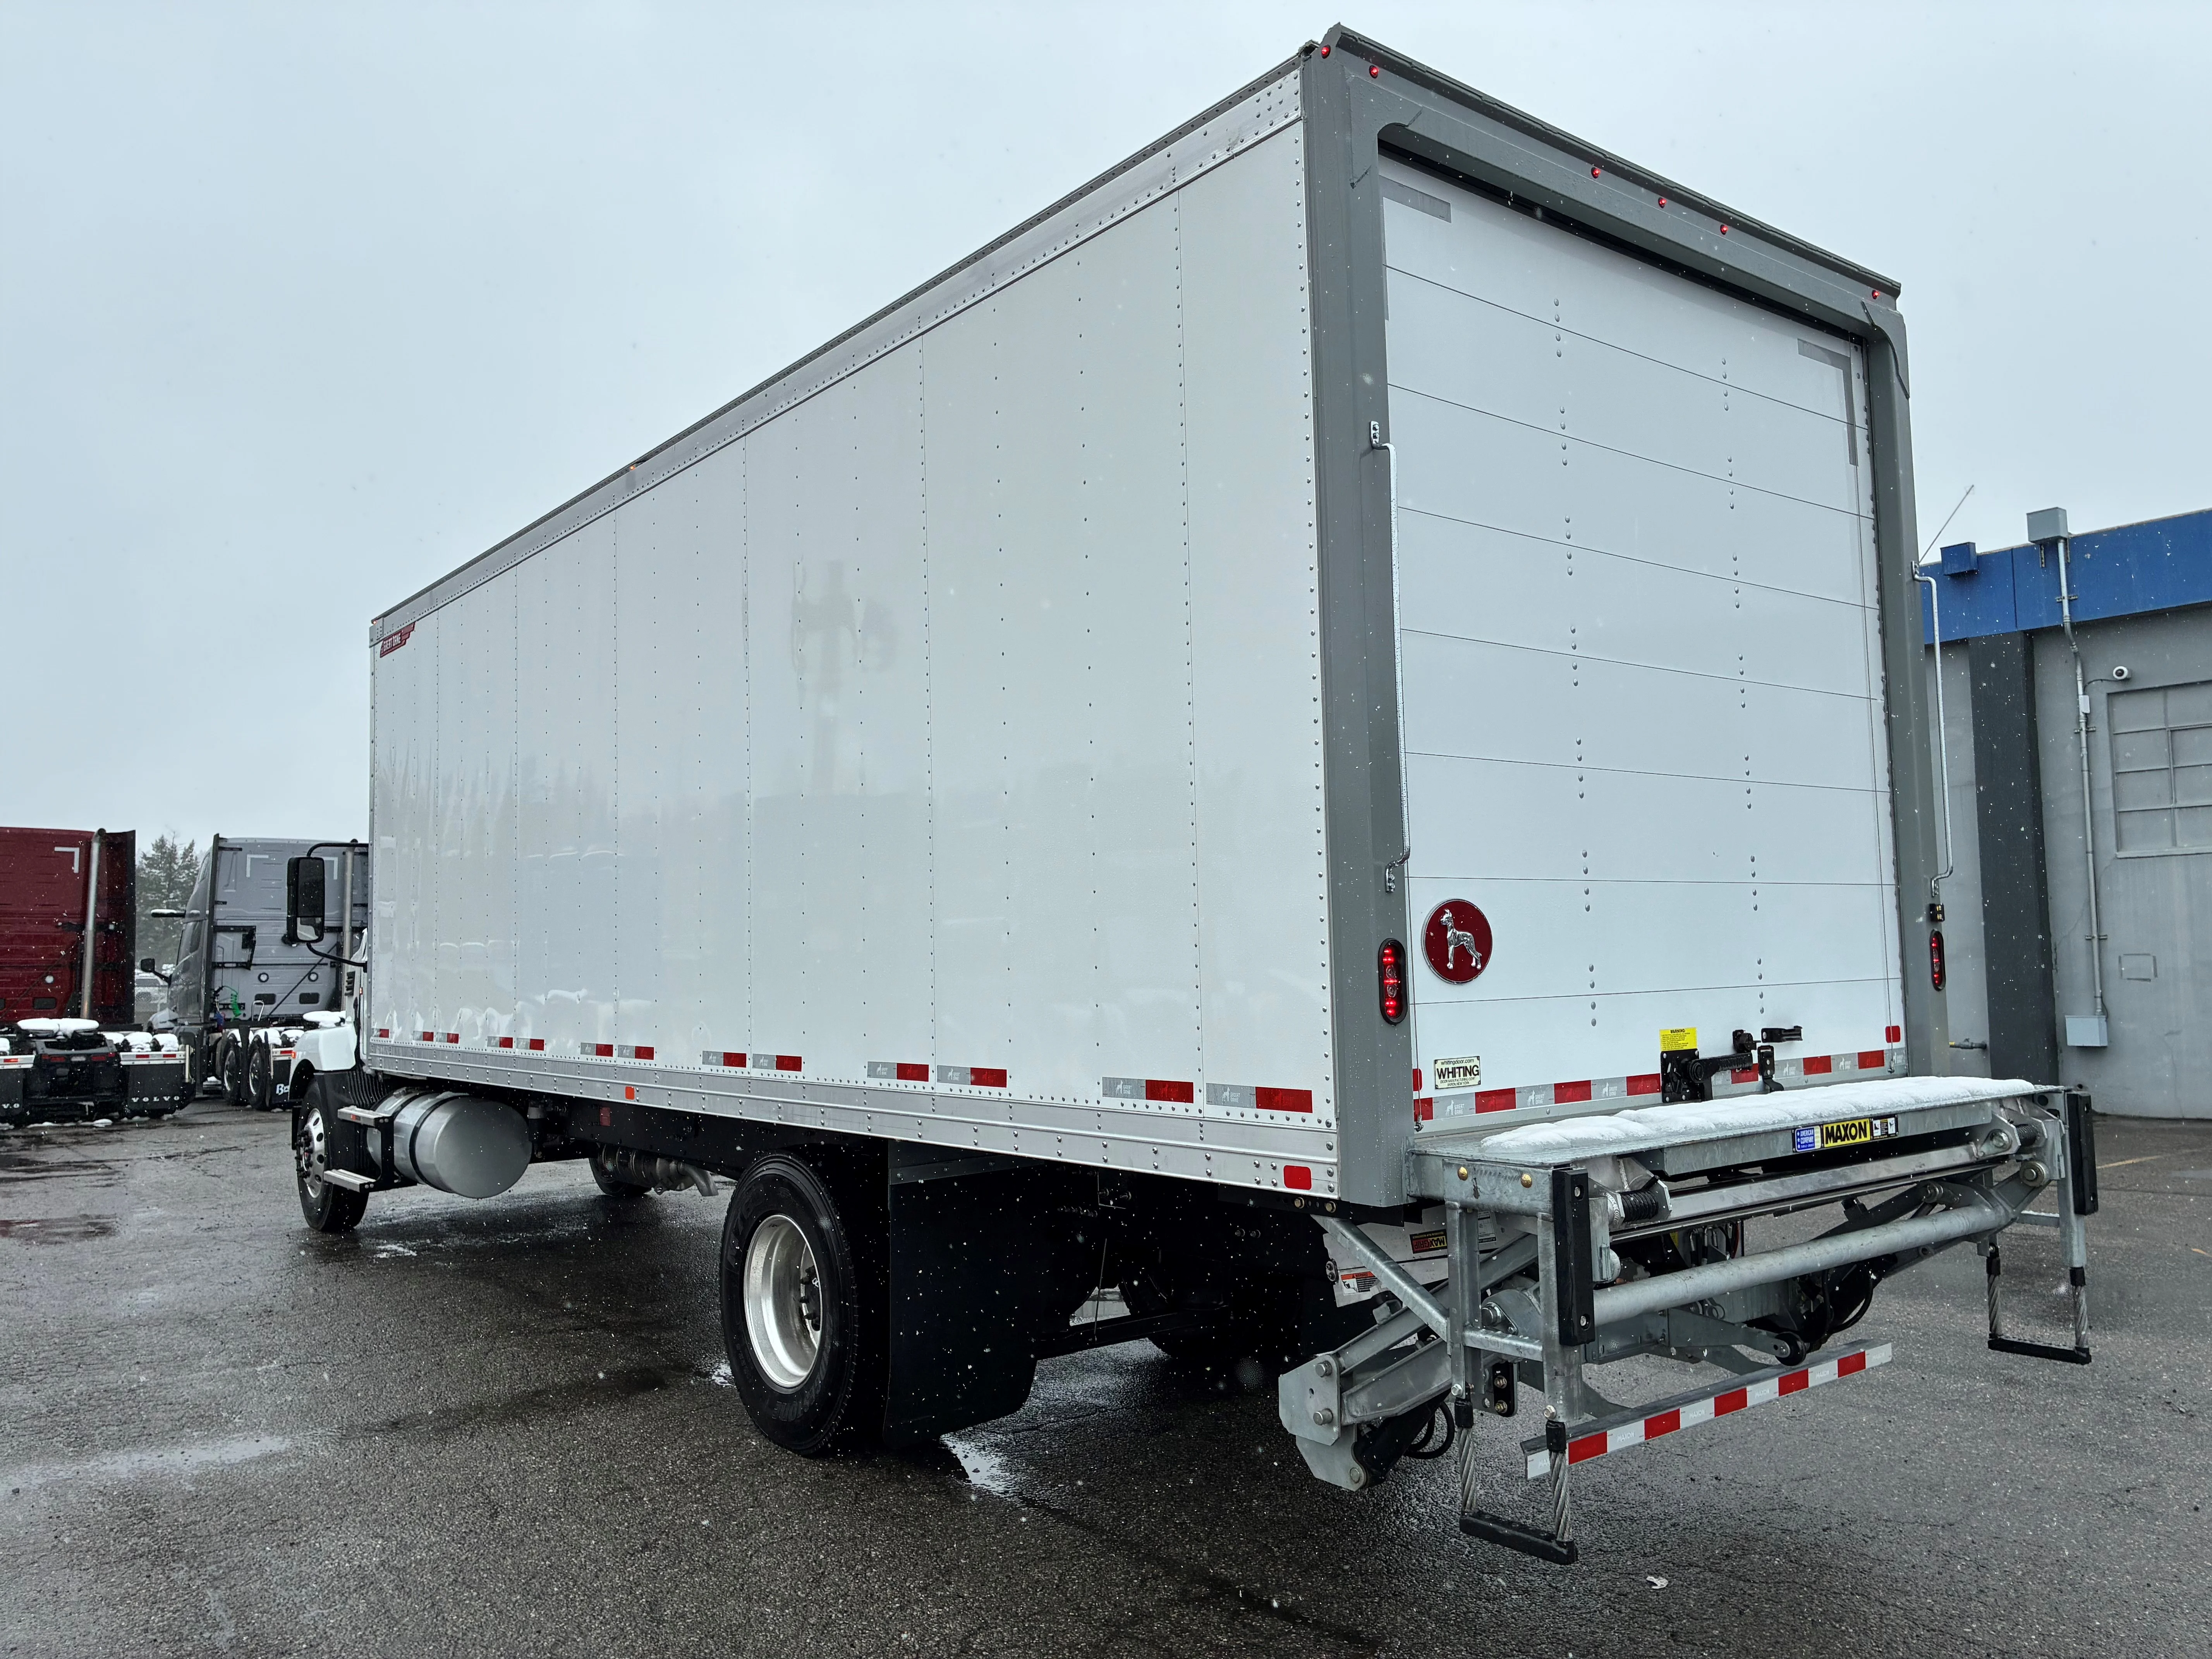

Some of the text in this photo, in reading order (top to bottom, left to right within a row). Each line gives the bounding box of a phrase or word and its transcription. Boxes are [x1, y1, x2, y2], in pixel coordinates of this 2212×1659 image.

[1436, 1065, 1479, 1080] WHITING
[1800, 1136, 1814, 1144] COMPANY
[1825, 1121, 1868, 1145] MAXON
